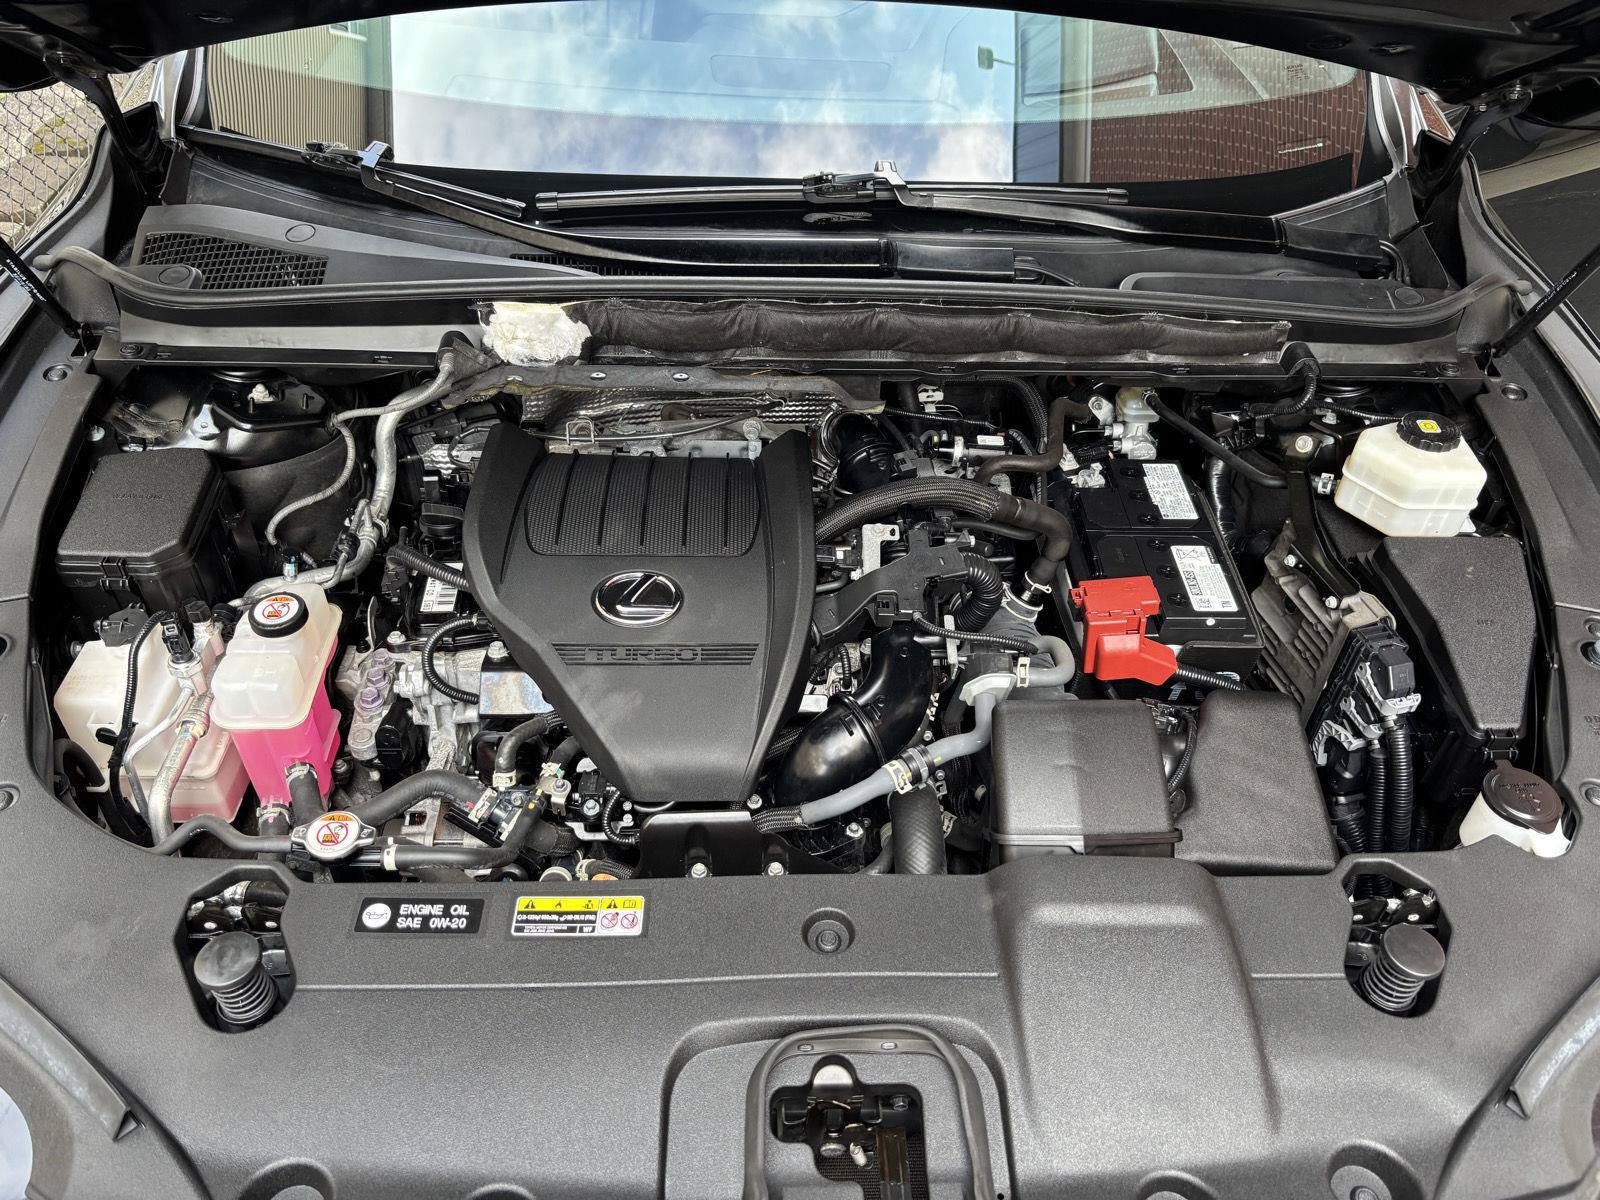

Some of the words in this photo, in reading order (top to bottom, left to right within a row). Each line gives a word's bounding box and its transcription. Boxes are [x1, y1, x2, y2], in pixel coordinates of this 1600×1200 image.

[588, 647, 699, 661] TURBO
[399, 904, 444, 915] ENGINE
[450, 905, 470, 916] OIL
[396, 917, 422, 928] SAE
[429, 917, 467, 929] 0W-20
